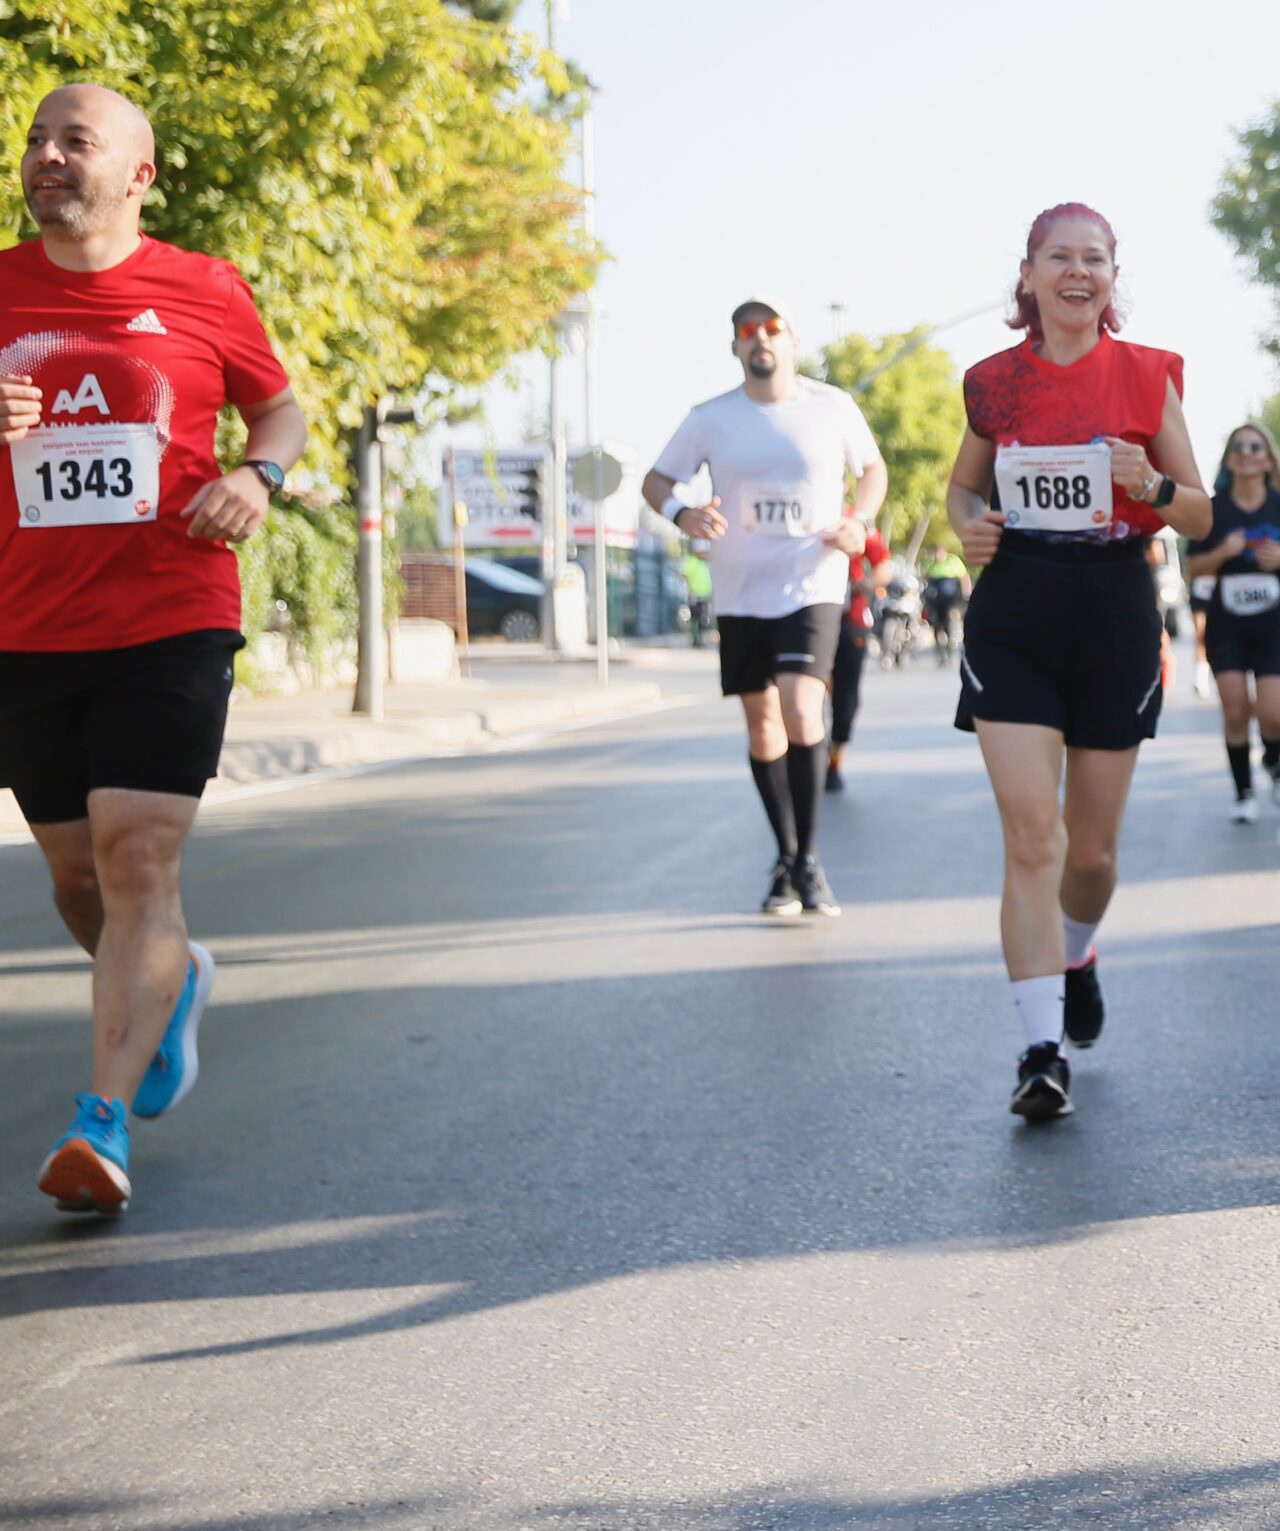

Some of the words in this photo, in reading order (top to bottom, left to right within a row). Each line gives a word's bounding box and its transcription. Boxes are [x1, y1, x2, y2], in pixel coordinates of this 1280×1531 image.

[35, 457, 134, 502] 1343
[1015, 475, 1091, 510] 1688
[753, 500, 802, 522] 1770
